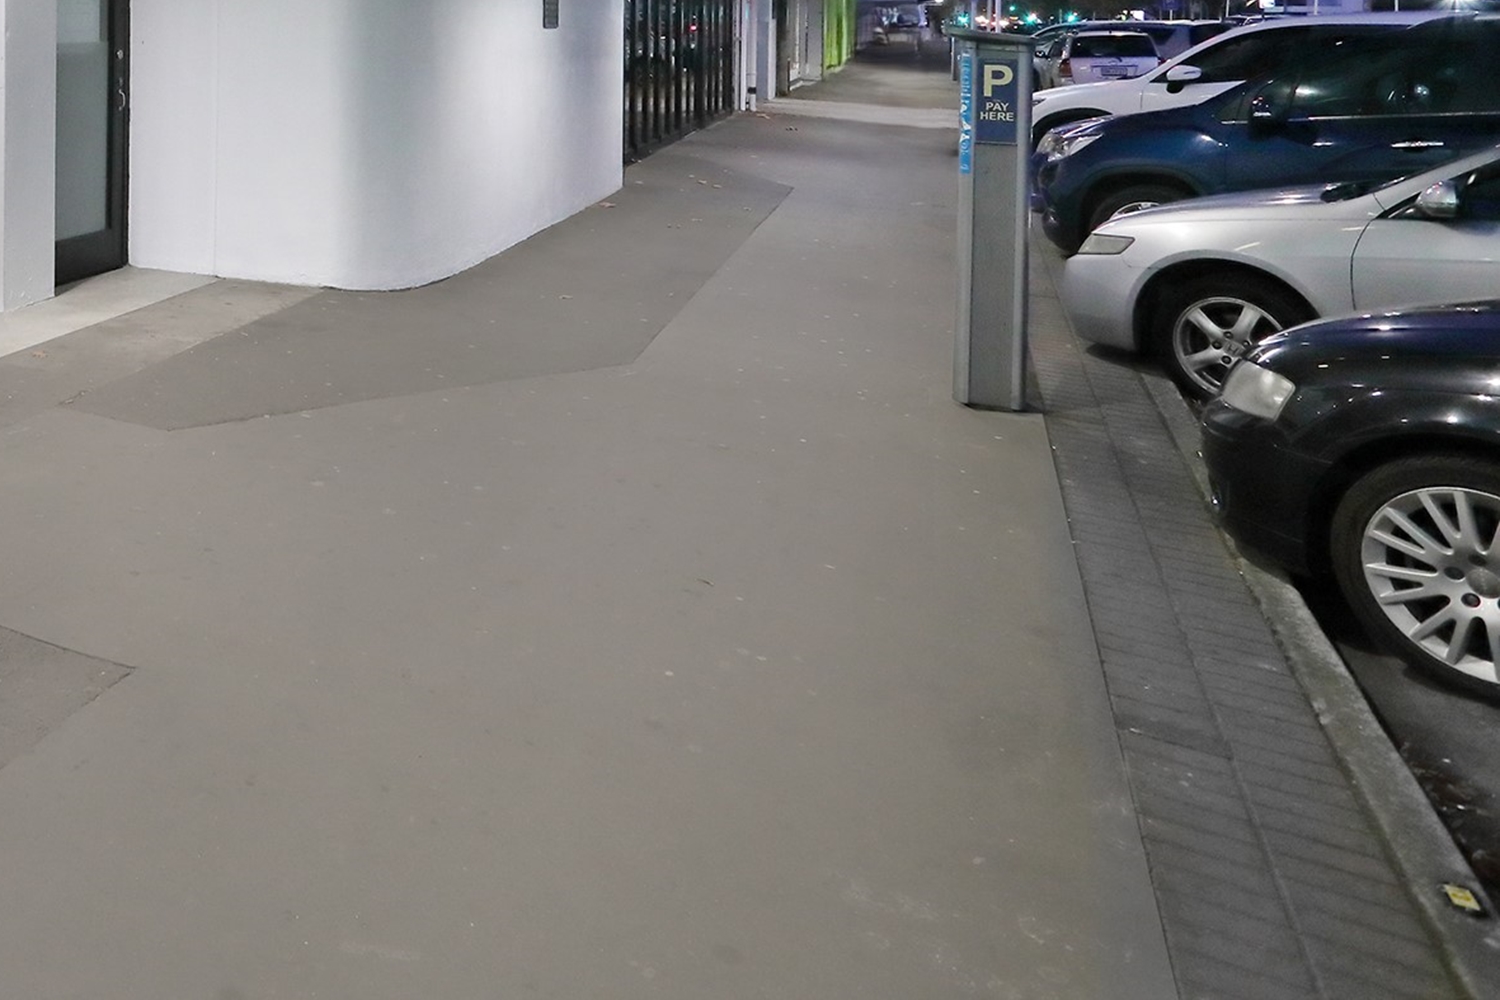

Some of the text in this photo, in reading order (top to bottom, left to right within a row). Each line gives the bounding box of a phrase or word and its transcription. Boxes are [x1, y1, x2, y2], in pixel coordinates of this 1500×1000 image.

[983, 64, 1014, 97] P
[985, 101, 1010, 111] PAY
[980, 112, 1015, 122] HERE
